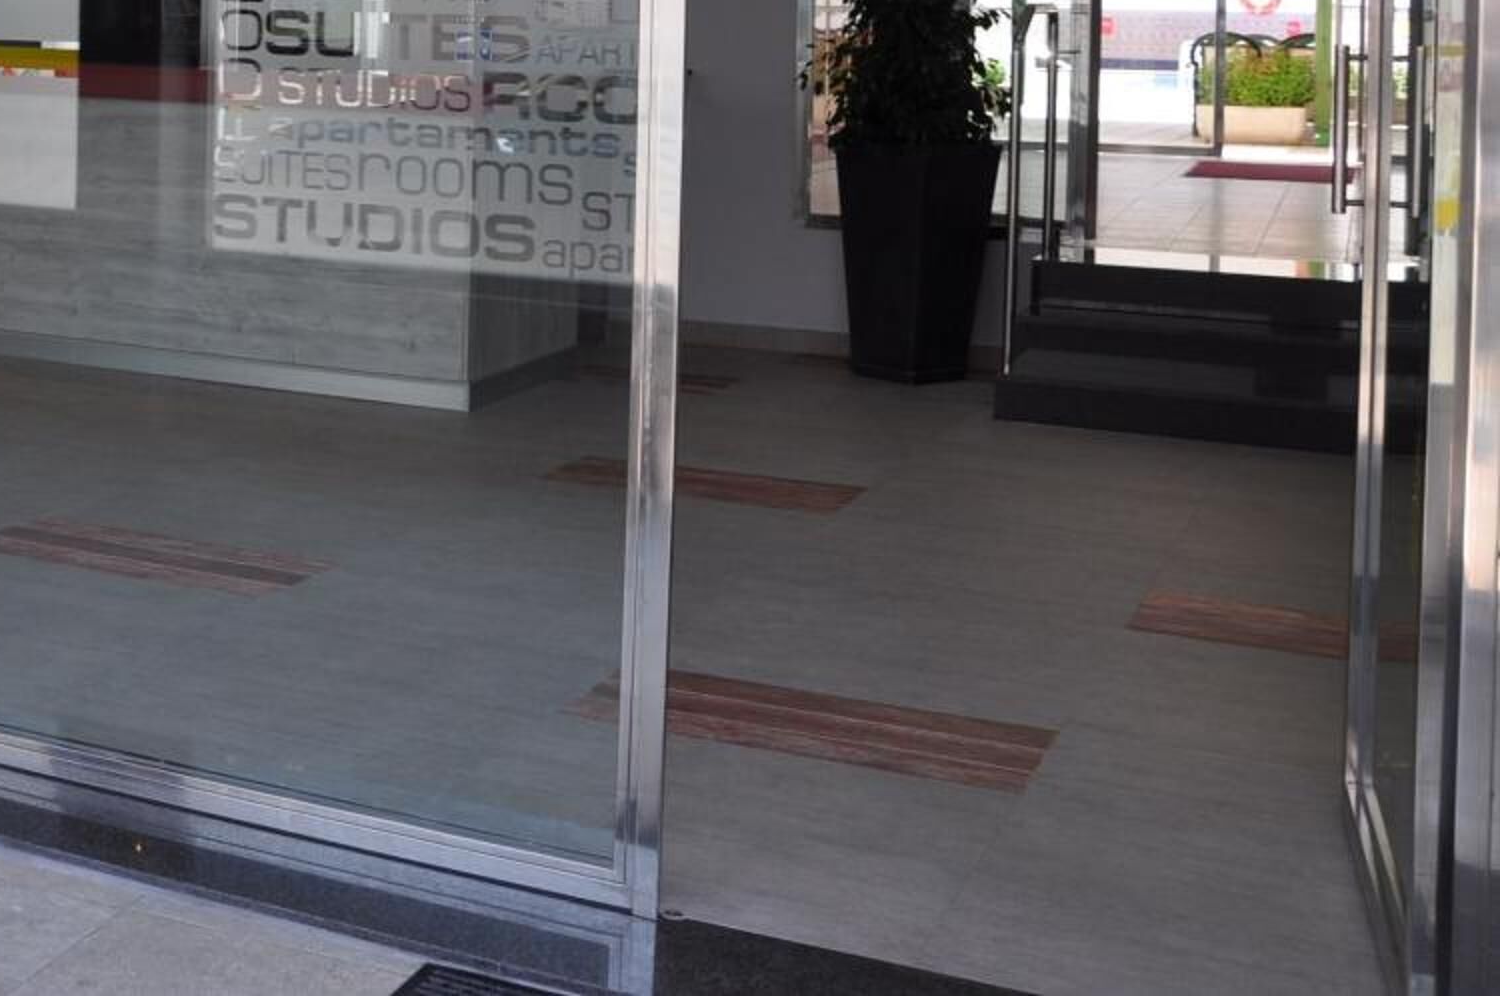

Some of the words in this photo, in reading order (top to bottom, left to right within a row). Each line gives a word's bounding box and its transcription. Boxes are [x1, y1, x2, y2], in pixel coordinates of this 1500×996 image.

[277, 67, 472, 113] STUDIOS
[357, 153, 573, 206] rooms
[213, 193, 536, 262] STUDIOS
